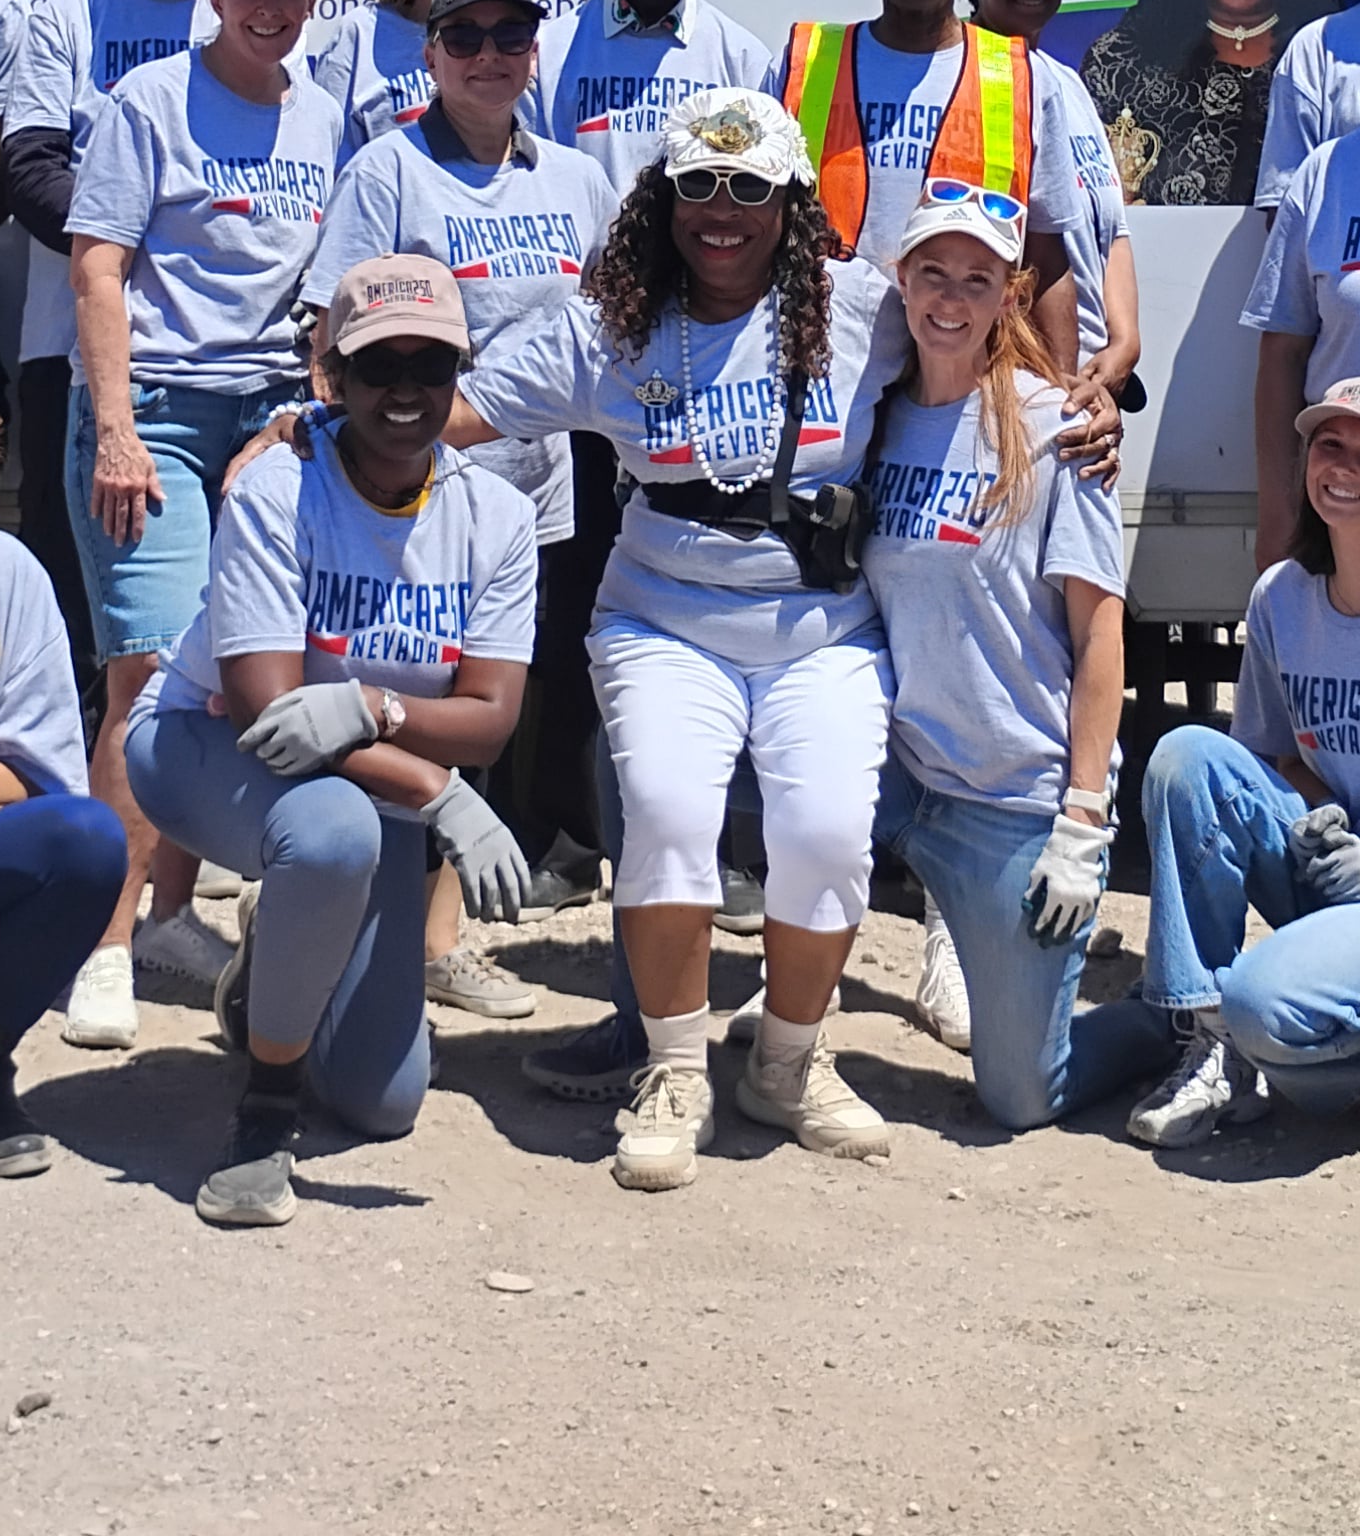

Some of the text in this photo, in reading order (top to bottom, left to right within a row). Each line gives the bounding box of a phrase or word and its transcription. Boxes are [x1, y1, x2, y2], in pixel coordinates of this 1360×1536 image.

[202, 156, 328, 205] AMERICA250
[252, 197, 313, 223] NEVADA
[444, 213, 582, 266] AMERICA250
[491, 254, 560, 278] NEVADA
[367, 279, 434, 304] AMERICA250
[350, 631, 438, 664] NEVADA
